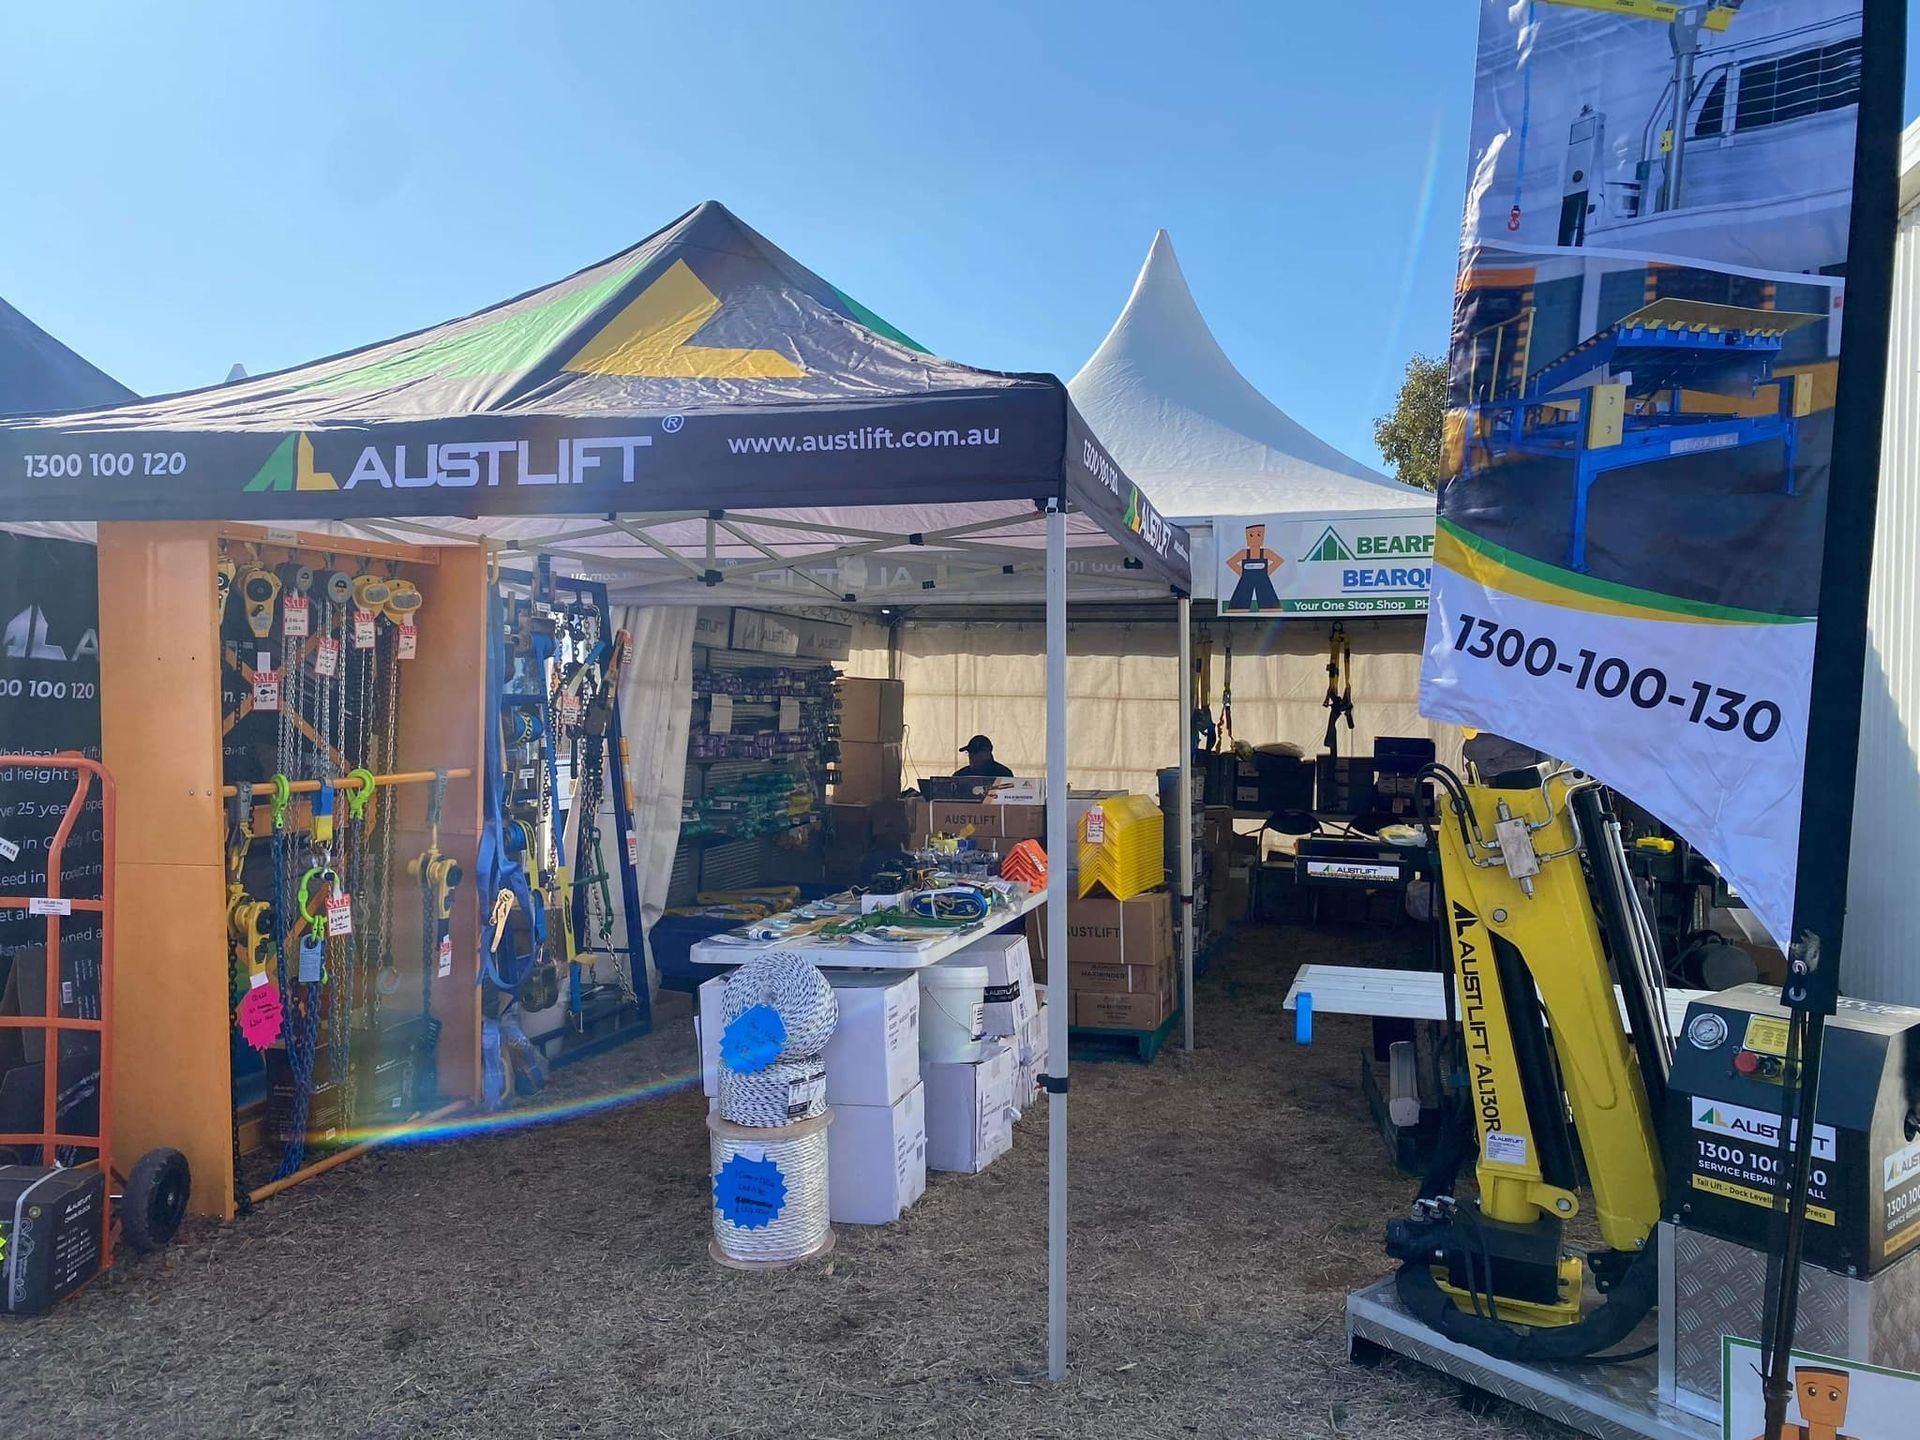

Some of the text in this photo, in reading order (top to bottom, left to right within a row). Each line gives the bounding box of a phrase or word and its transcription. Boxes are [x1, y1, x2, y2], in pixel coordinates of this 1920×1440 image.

[728, 427, 1000, 454] www.austlift.com.au
[24, 452, 187, 477] 1300 100 120
[343, 436, 652, 489] AUSTLIFT
[1083, 439, 1099, 475] 1300
[284, 599, 308, 608] SALE
[1294, 601, 1319, 611] Your
[1322, 601, 1345, 610] One
[1348, 600, 1373, 610] Stop
[1376, 600, 1406, 609] Shop
[254, 672, 278, 682] SALE
[1453, 613, 1782, 742] 1300-100-130
[29, 680, 66, 699] 100
[71, 683, 94, 699] 120
[17, 767, 69, 783] height
[17, 802, 35, 815] 25
[945, 815, 997, 825] AUSTLIFT
[31, 870, 46, 883] in
[1337, 867, 1379, 875] AUSTLIFT
[327, 896, 350, 908] SALE
[1067, 926, 1120, 938] USTLIFT
[1458, 940, 1490, 1055] AUSTLIFT
[1475, 1063, 1501, 1133] AL130R
[1698, 1141, 1744, 1165] 1300
[1698, 1159, 1741, 1178] SERVICE
[1697, 1178, 1709, 1187] Tail
[1710, 1182, 1722, 1191] Lift
[1730, 1187, 1748, 1198] Dock
[1887, 1194, 1907, 1218] 1300
